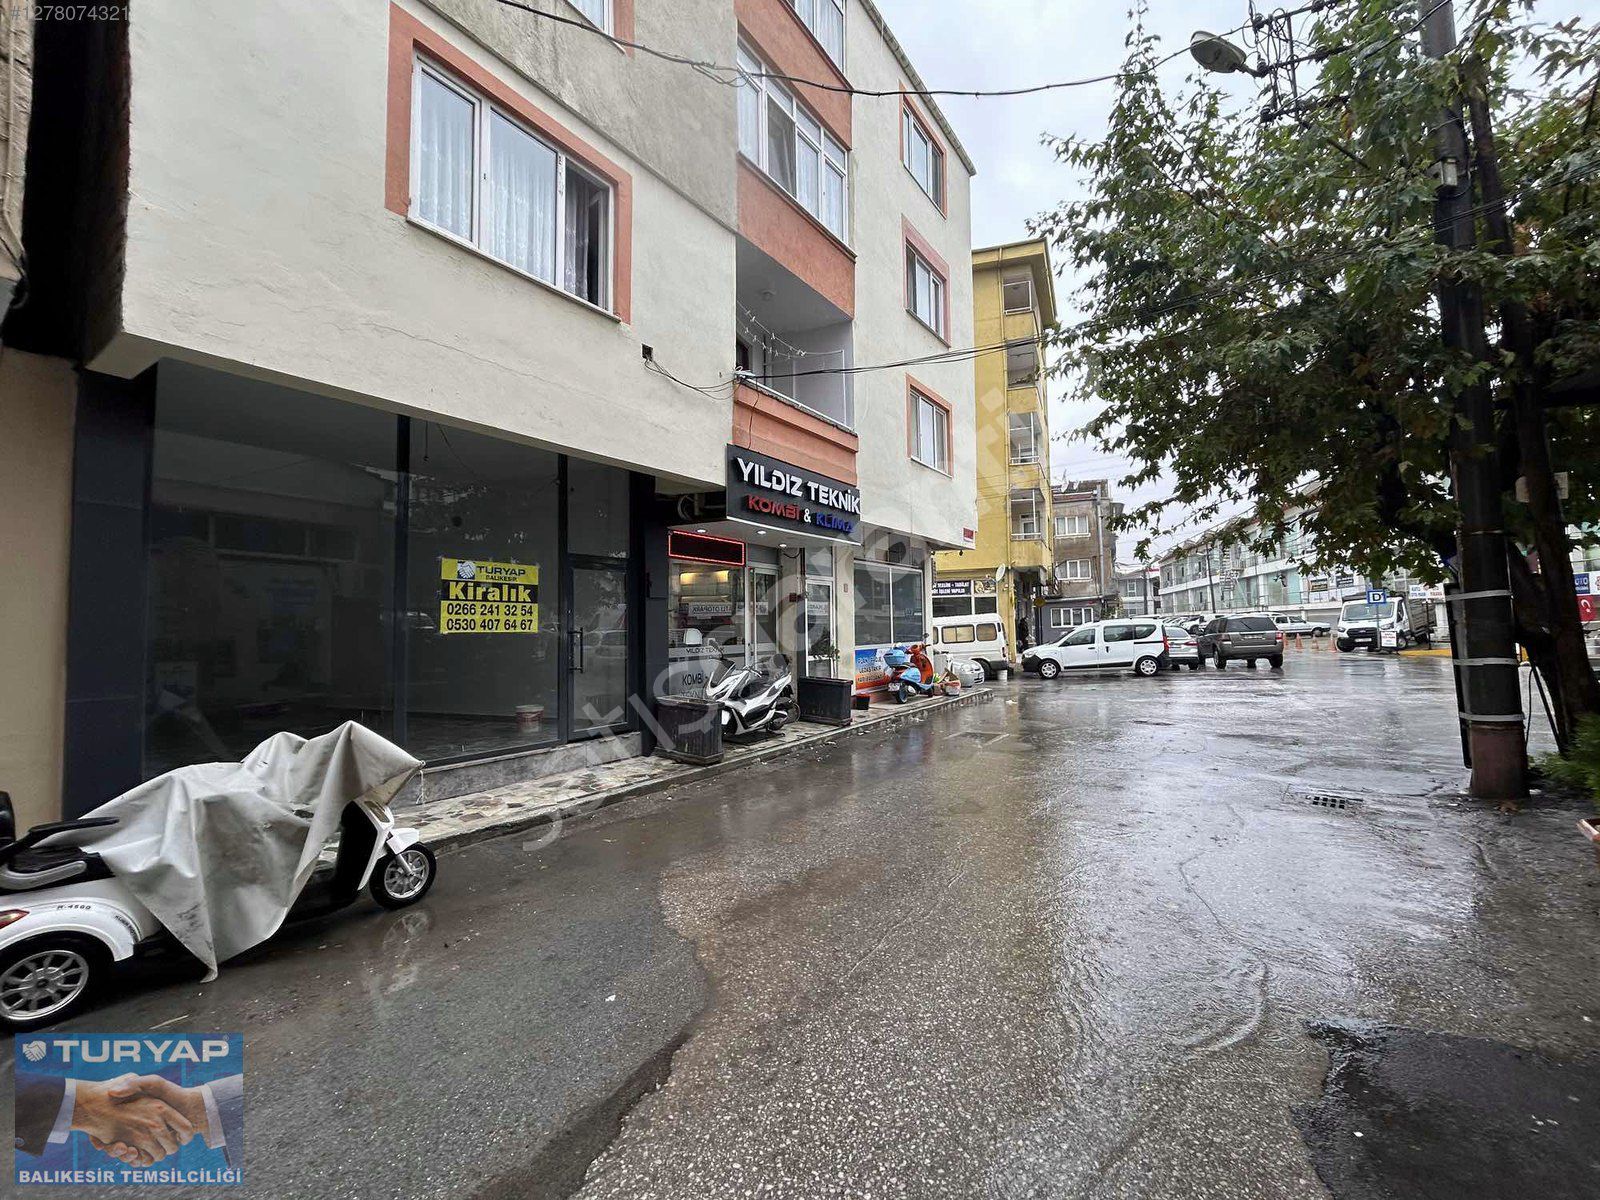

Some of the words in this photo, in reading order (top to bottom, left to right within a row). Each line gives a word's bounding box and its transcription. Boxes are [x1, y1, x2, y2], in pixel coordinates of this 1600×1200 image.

[737, 457, 803, 498] YILDIZ
[807, 480, 861, 515] TEKNİK
[747, 496, 800, 521] KOMBİ
[803, 508, 812, 523] &
[476, 565, 526, 577] TURYAP
[449, 581, 532, 602] Kiralık
[447, 603, 476, 616] 0266
[480, 604, 500, 616] 241
[504, 605, 518, 617] 32
[521, 605, 533, 617] 54
[446, 618, 476, 631] 0530
[479, 619, 501, 631] 407
[504, 619, 517, 631] 64
[520, 619, 533, 631] 67
